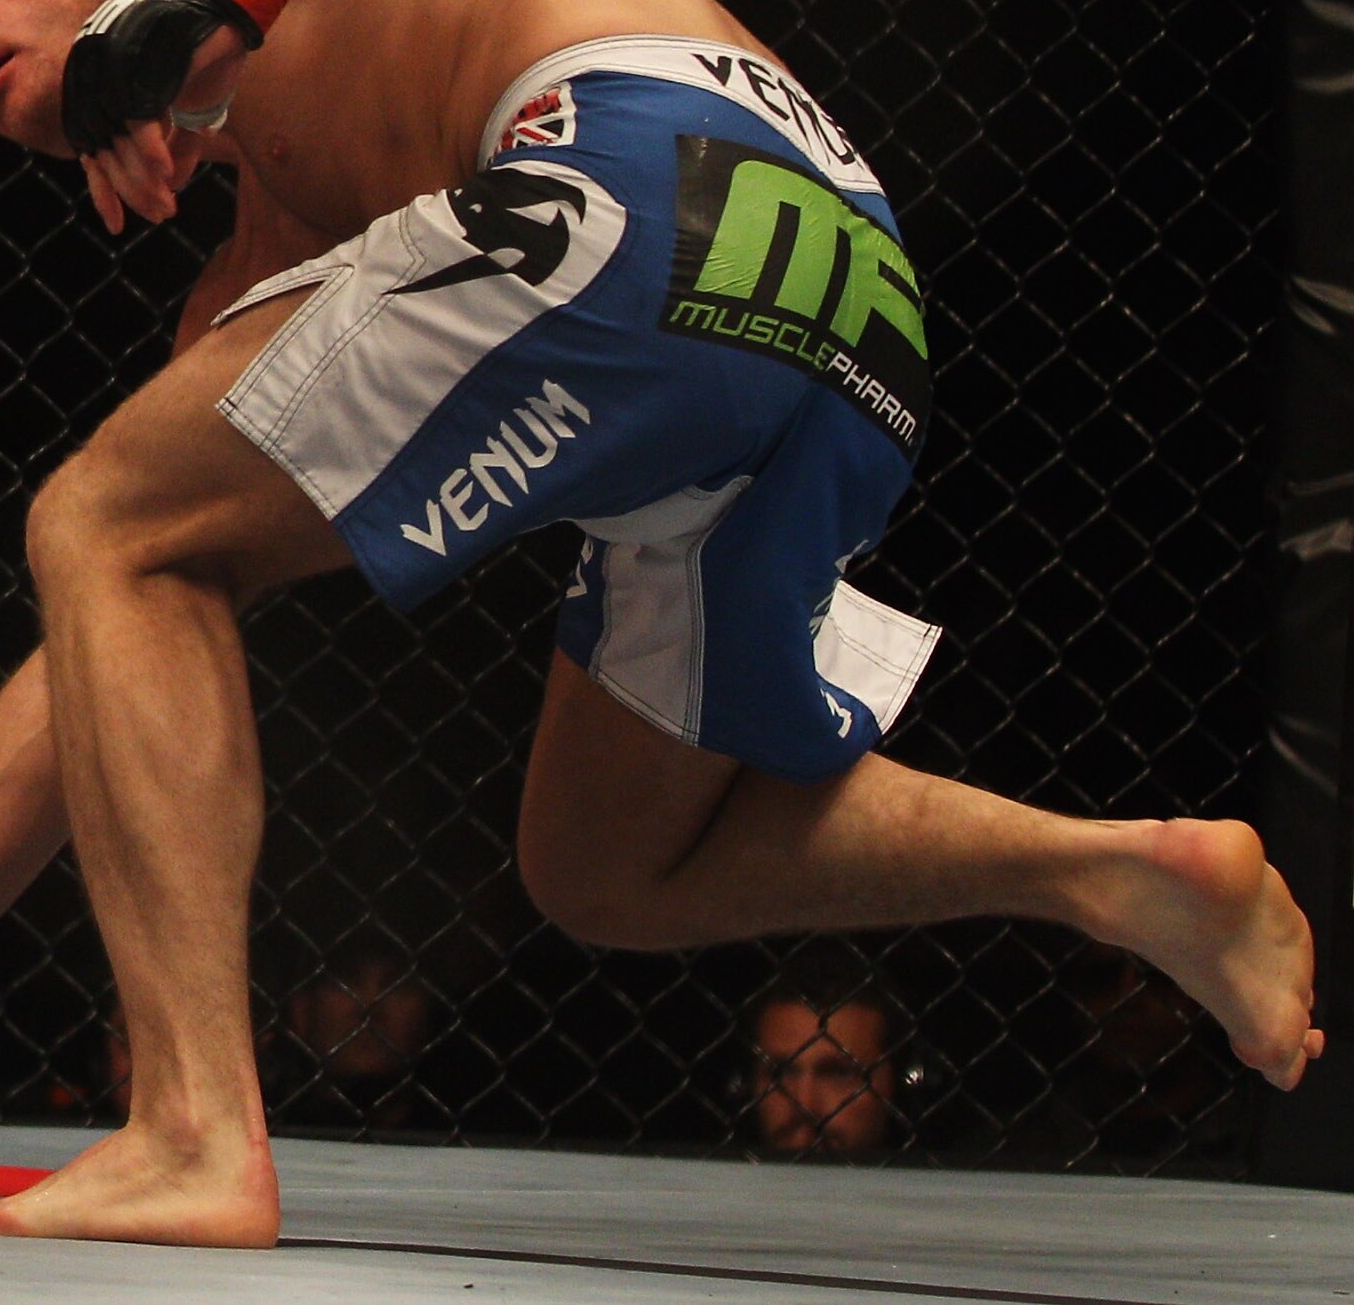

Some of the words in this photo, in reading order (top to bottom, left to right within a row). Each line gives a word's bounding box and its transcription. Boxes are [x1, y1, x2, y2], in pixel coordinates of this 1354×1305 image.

[691, 52, 866, 172] VENU
[668, 301, 918, 445] MUSCLEPHARM
[399, 378, 591, 557] VENUM
